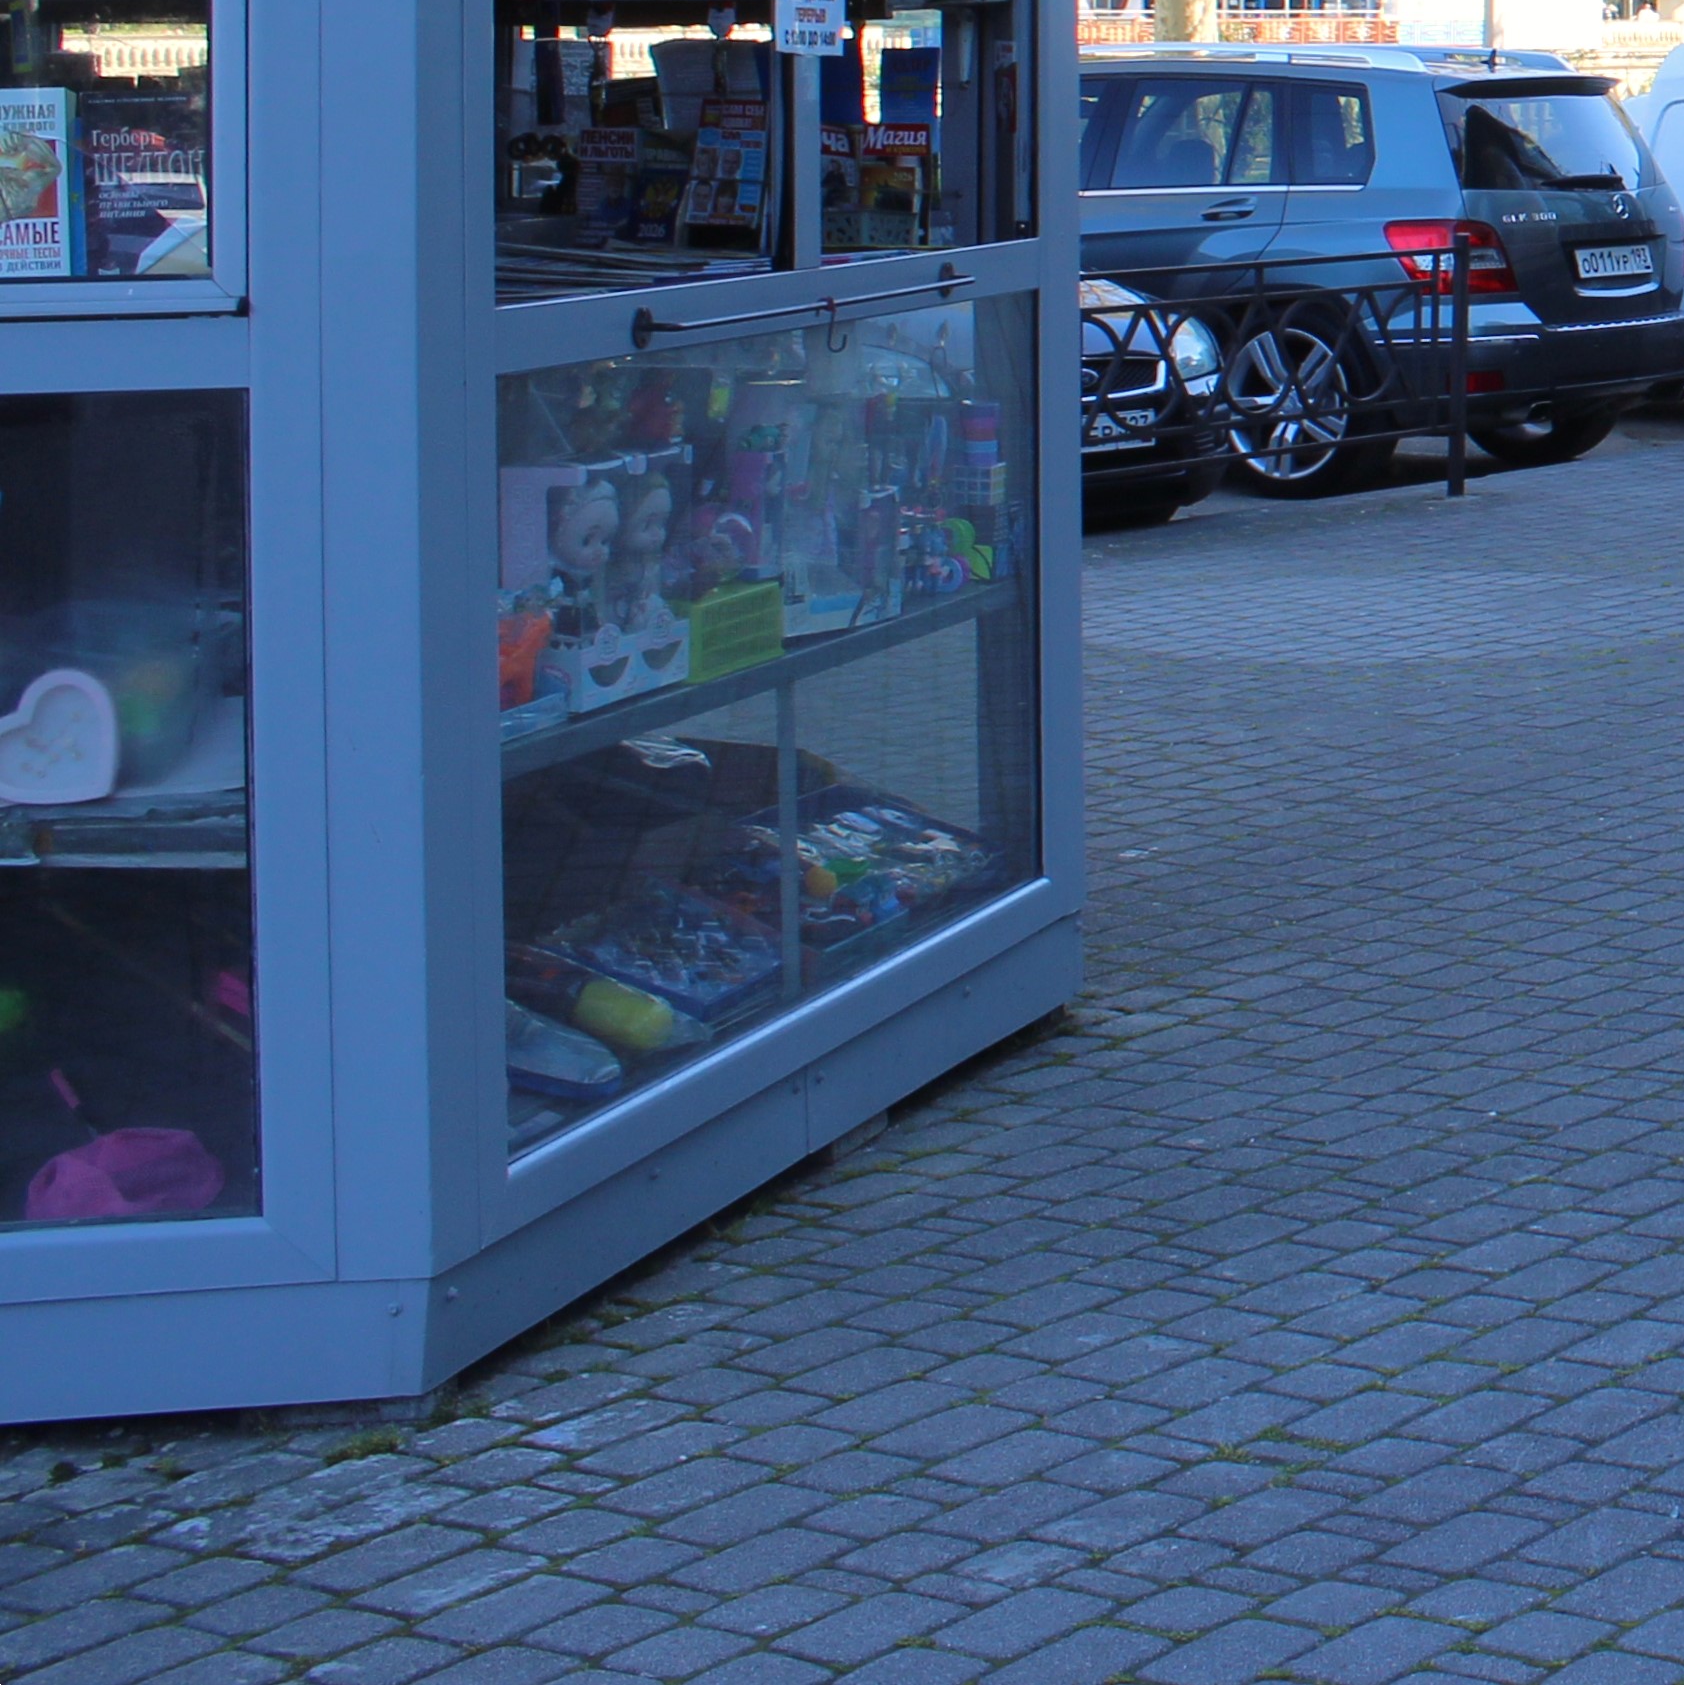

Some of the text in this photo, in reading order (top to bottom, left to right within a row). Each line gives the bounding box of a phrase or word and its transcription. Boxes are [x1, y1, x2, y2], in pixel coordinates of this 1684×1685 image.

[795, 6, 827, 24] ПЕРЕРЫВ
[0, 104, 56, 121] УЖНАЯ
[92, 127, 155, 151] Герберт
[579, 129, 635, 146] ПЕНСИИ
[862, 125, 928, 150] Магия
[588, 146, 635, 159] ЛЬГОТЫ
[93, 149, 206, 186] ШЕЛТОН
[637, 224, 666, 238] 2026
[32, 246, 62, 260] ТЕСТЫ
[1631, 247, 1649, 266] 193
[7, 260, 62, 274] ДЕЙСТВИИ
